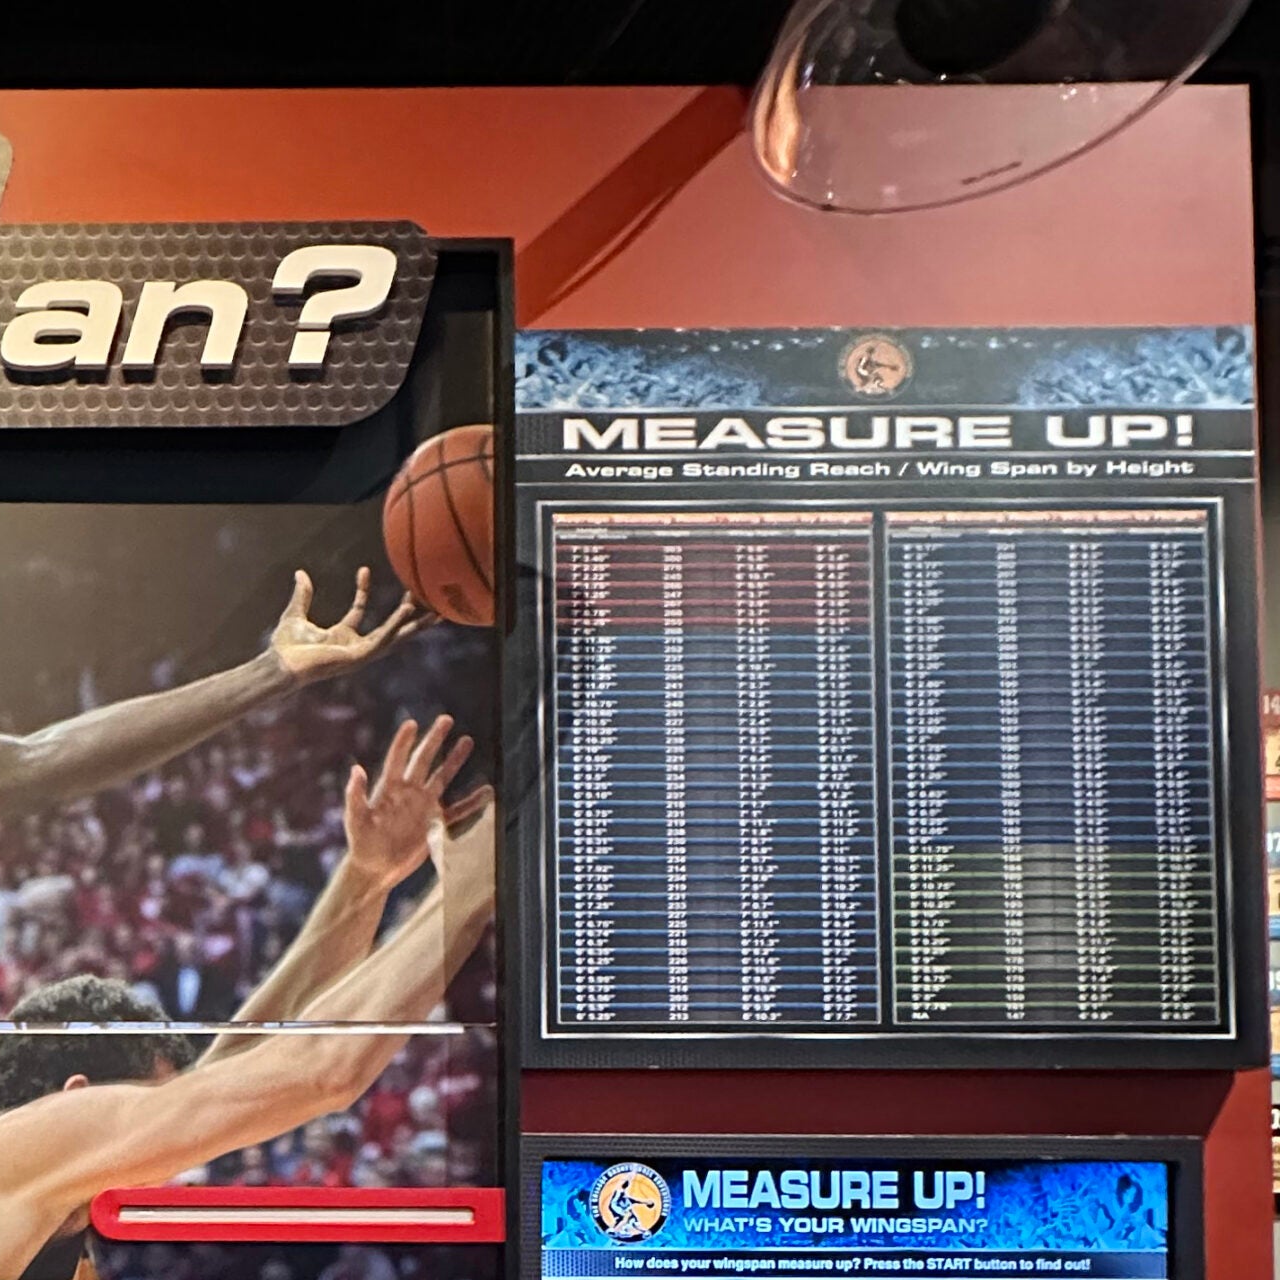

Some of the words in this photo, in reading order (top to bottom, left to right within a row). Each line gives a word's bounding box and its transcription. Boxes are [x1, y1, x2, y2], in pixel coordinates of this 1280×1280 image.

[563, 415, 1012, 450] MEASURE
[1045, 414, 1193, 449] UP!
[565, 462, 674, 480] Average
[682, 462, 800, 479] Standing
[810, 461, 891, 477] Reach
[898, 461, 909, 476] /
[918, 460, 982, 478] Wing
[990, 461, 1058, 477] Span
[1066, 460, 1097, 477] by
[1106, 460, 1196, 477] Height
[682, 1170, 899, 1210] MEASURE
[913, 1171, 986, 1210] UP!
[684, 1217, 772, 1234] WHAT'S
[780, 1218, 845, 1234] YOUR
[850, 1217, 989, 1234] WINGSPAN?
[615, 1256, 644, 1270] How
[646, 1257, 679, 1270] does
[681, 1259, 711, 1273] your
[713, 1257, 777, 1274] wingspan
[778, 1259, 833, 1271] measure
[835, 1257, 861, 1274] up?
[863, 1258, 901, 1271] Press
[903, 1258, 924, 1271] the
[926, 1258, 972, 1271] START
[974, 1258, 1017, 1271] button
[1019, 1259, 1034, 1271] to
[1035, 1258, 1062, 1271] find
[1064, 1258, 1091, 1272] out!
